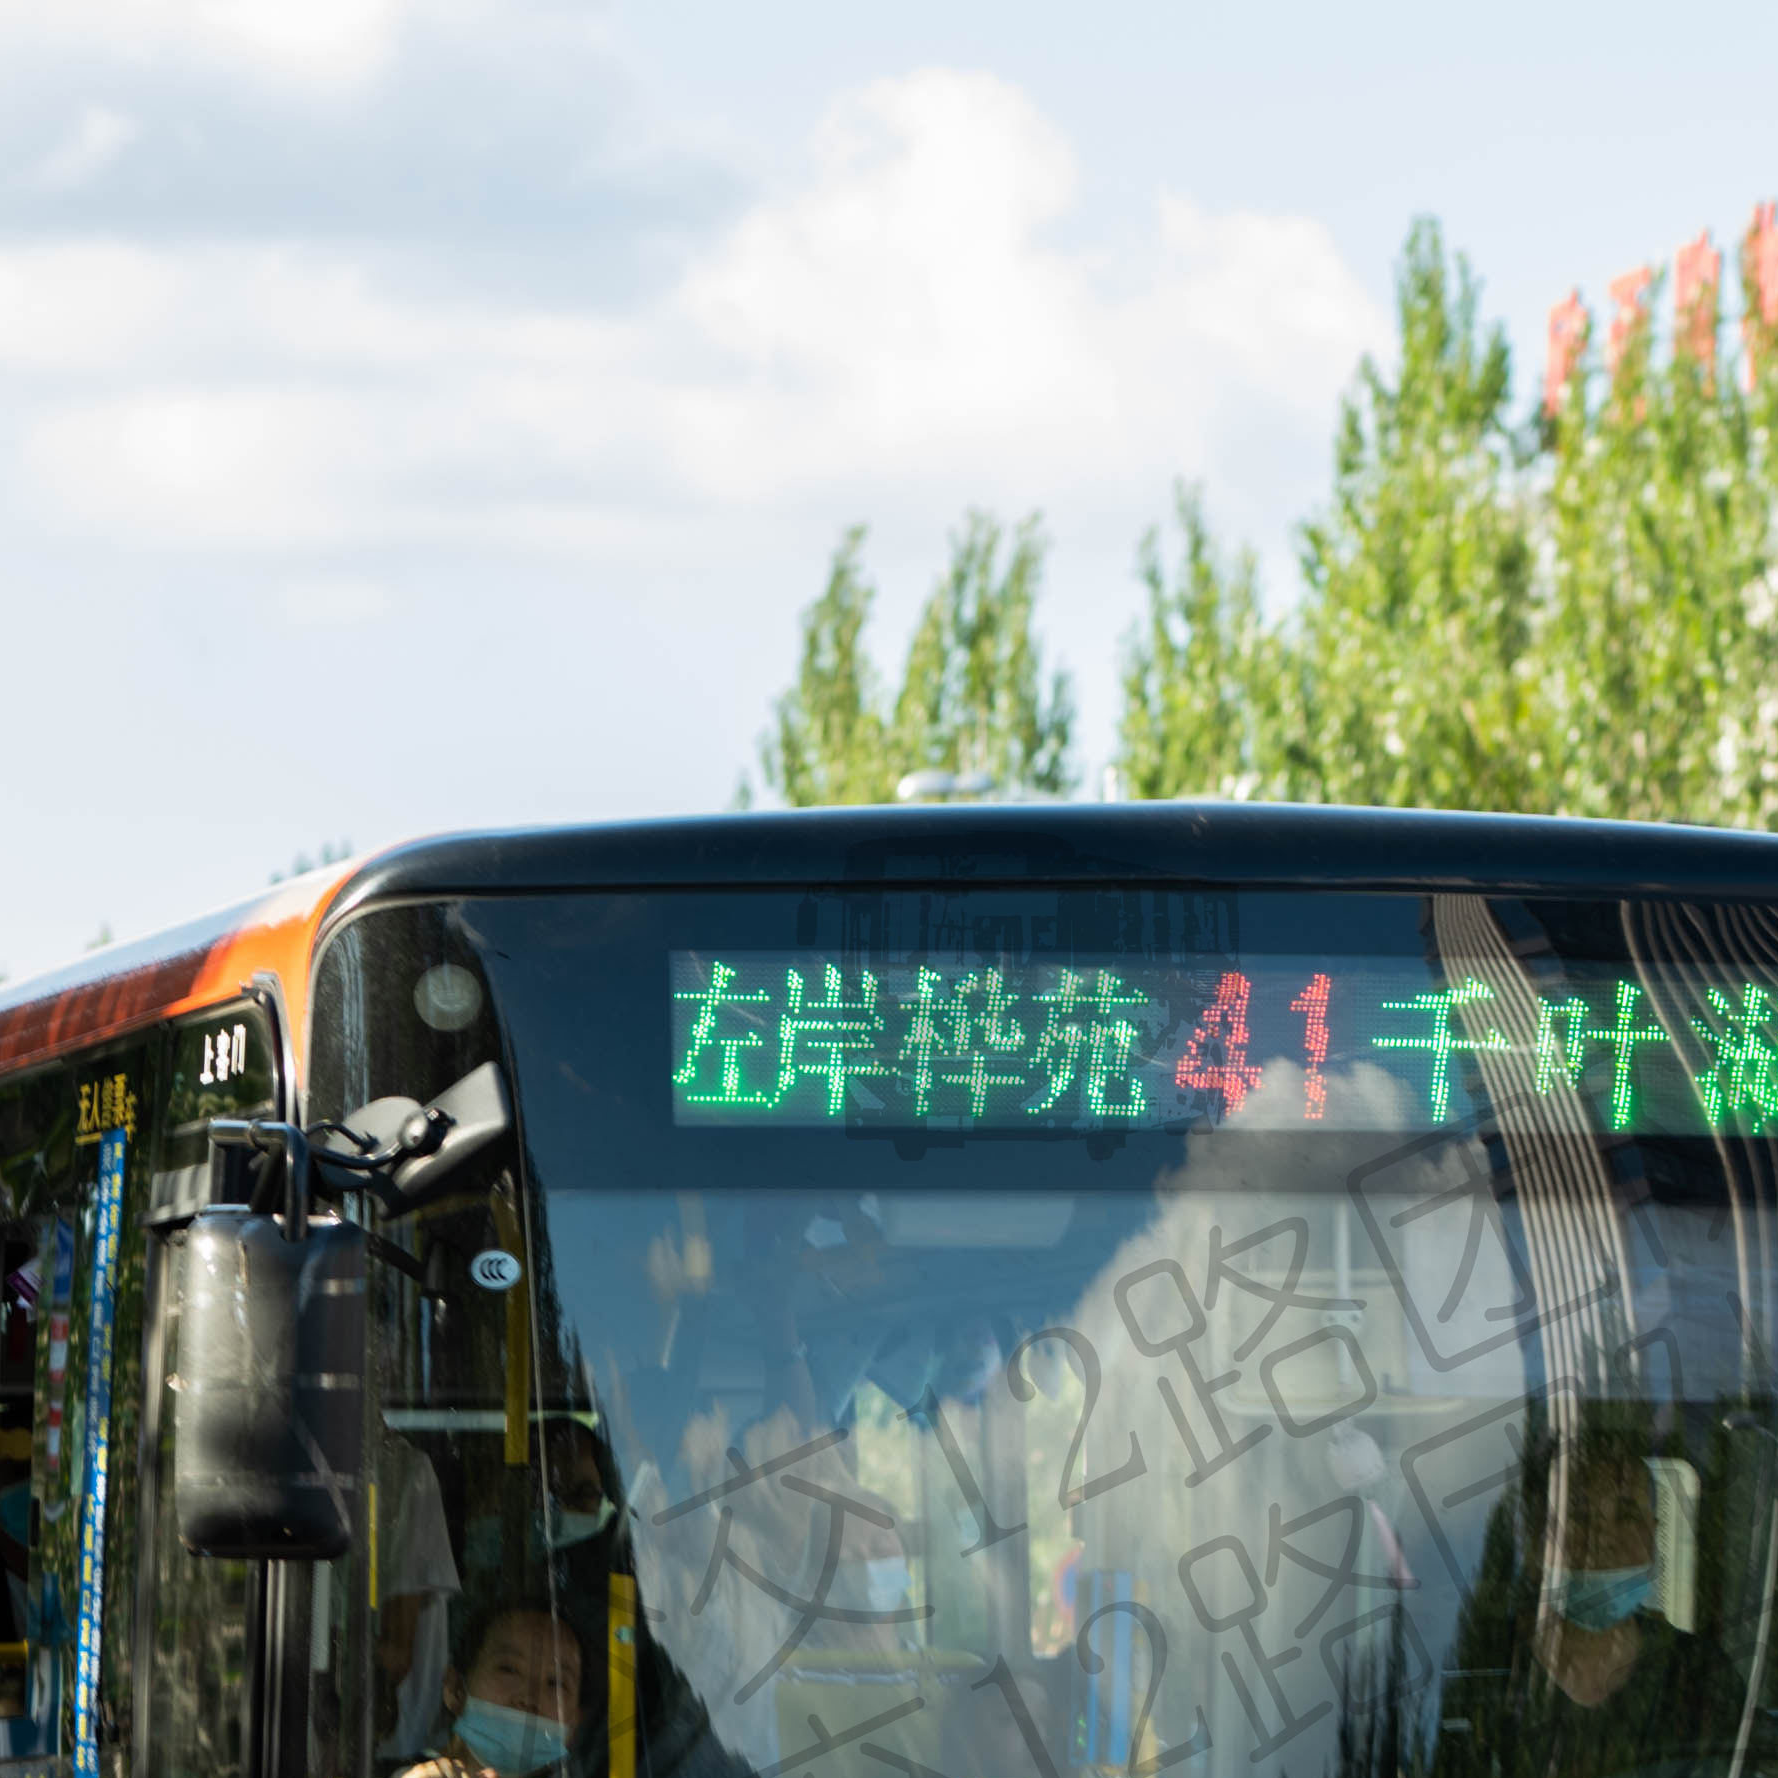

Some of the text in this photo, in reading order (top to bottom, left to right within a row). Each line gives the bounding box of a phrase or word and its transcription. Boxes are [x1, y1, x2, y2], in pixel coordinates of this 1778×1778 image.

[200, 1023, 247, 1086] 上客门
[671, 960, 1151, 1117] 左岸桦苑
[1175, 970, 1334, 1121] 41
